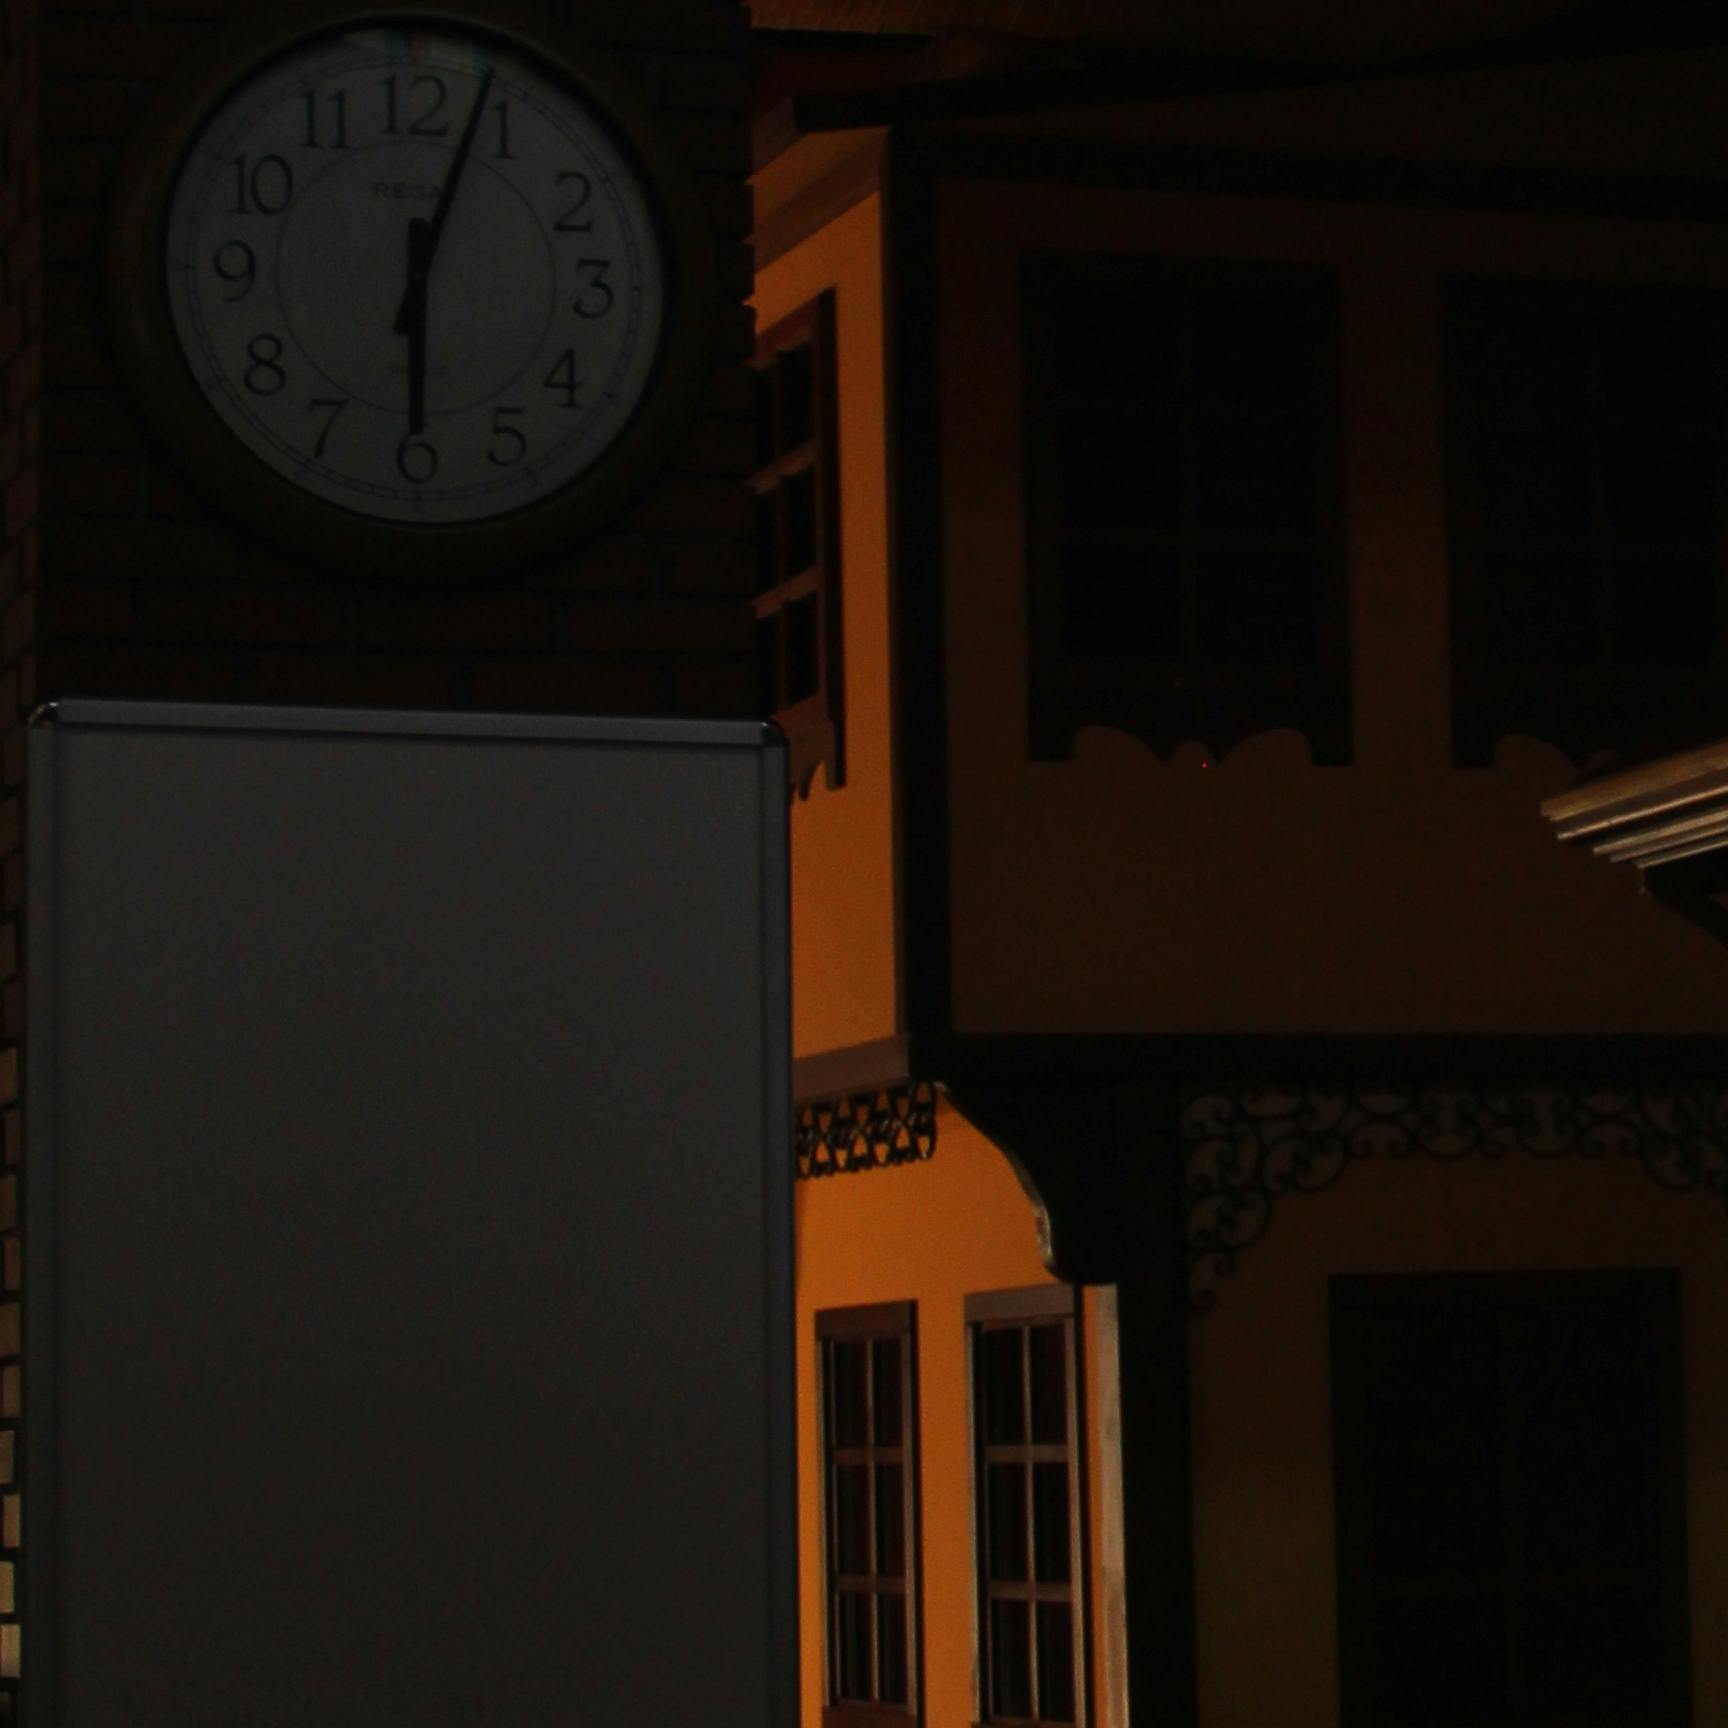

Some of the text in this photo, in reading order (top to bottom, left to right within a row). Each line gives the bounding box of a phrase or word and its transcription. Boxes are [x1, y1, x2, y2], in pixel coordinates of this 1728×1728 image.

[299, 89, 352, 149] 11
[382, 75, 448, 137] 12
[491, 100, 514, 159] 1
[232, 154, 293, 215] 10
[553, 172, 593, 232] 2
[213, 240, 256, 302] 9
[573, 259, 613, 319] 3
[244, 334, 286, 395] 8
[543, 348, 583, 408] 4
[308, 399, 349, 459] 7
[397, 425, 438, 483] 6
[487, 407, 527, 466] 5
